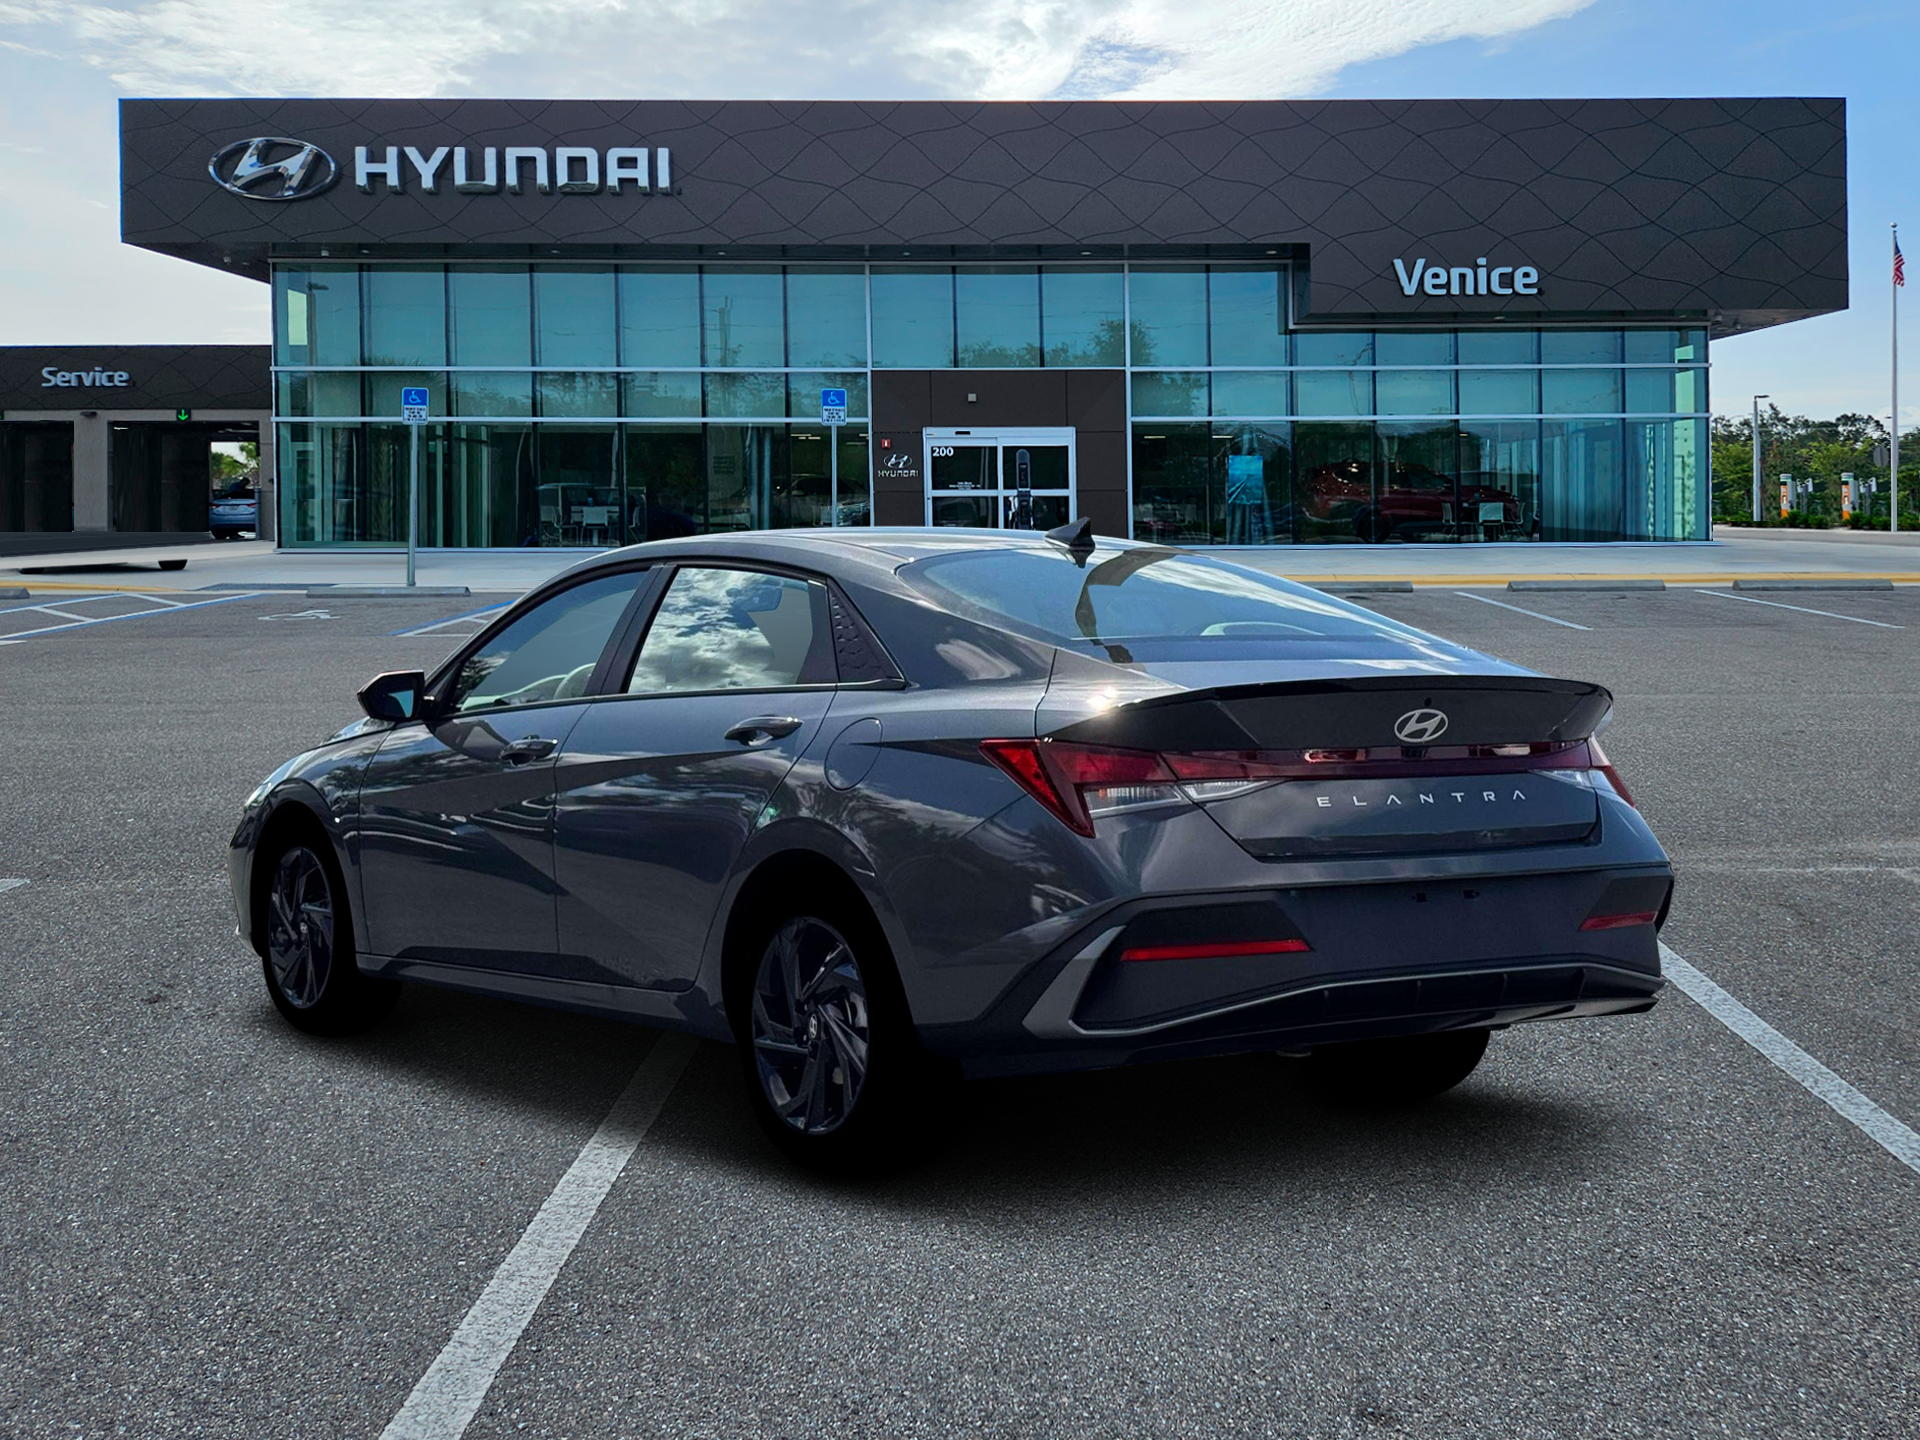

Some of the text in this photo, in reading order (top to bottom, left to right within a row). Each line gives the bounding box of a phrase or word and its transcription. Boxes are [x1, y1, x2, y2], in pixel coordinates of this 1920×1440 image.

[355, 146, 671, 193] HYUNDAI
[1393, 257, 1539, 296] Venice
[41, 366, 130, 387] Service
[932, 446, 954, 457] 200
[877, 469, 919, 477] HYUNDAI
[1316, 789, 1526, 807] ELANTRA
